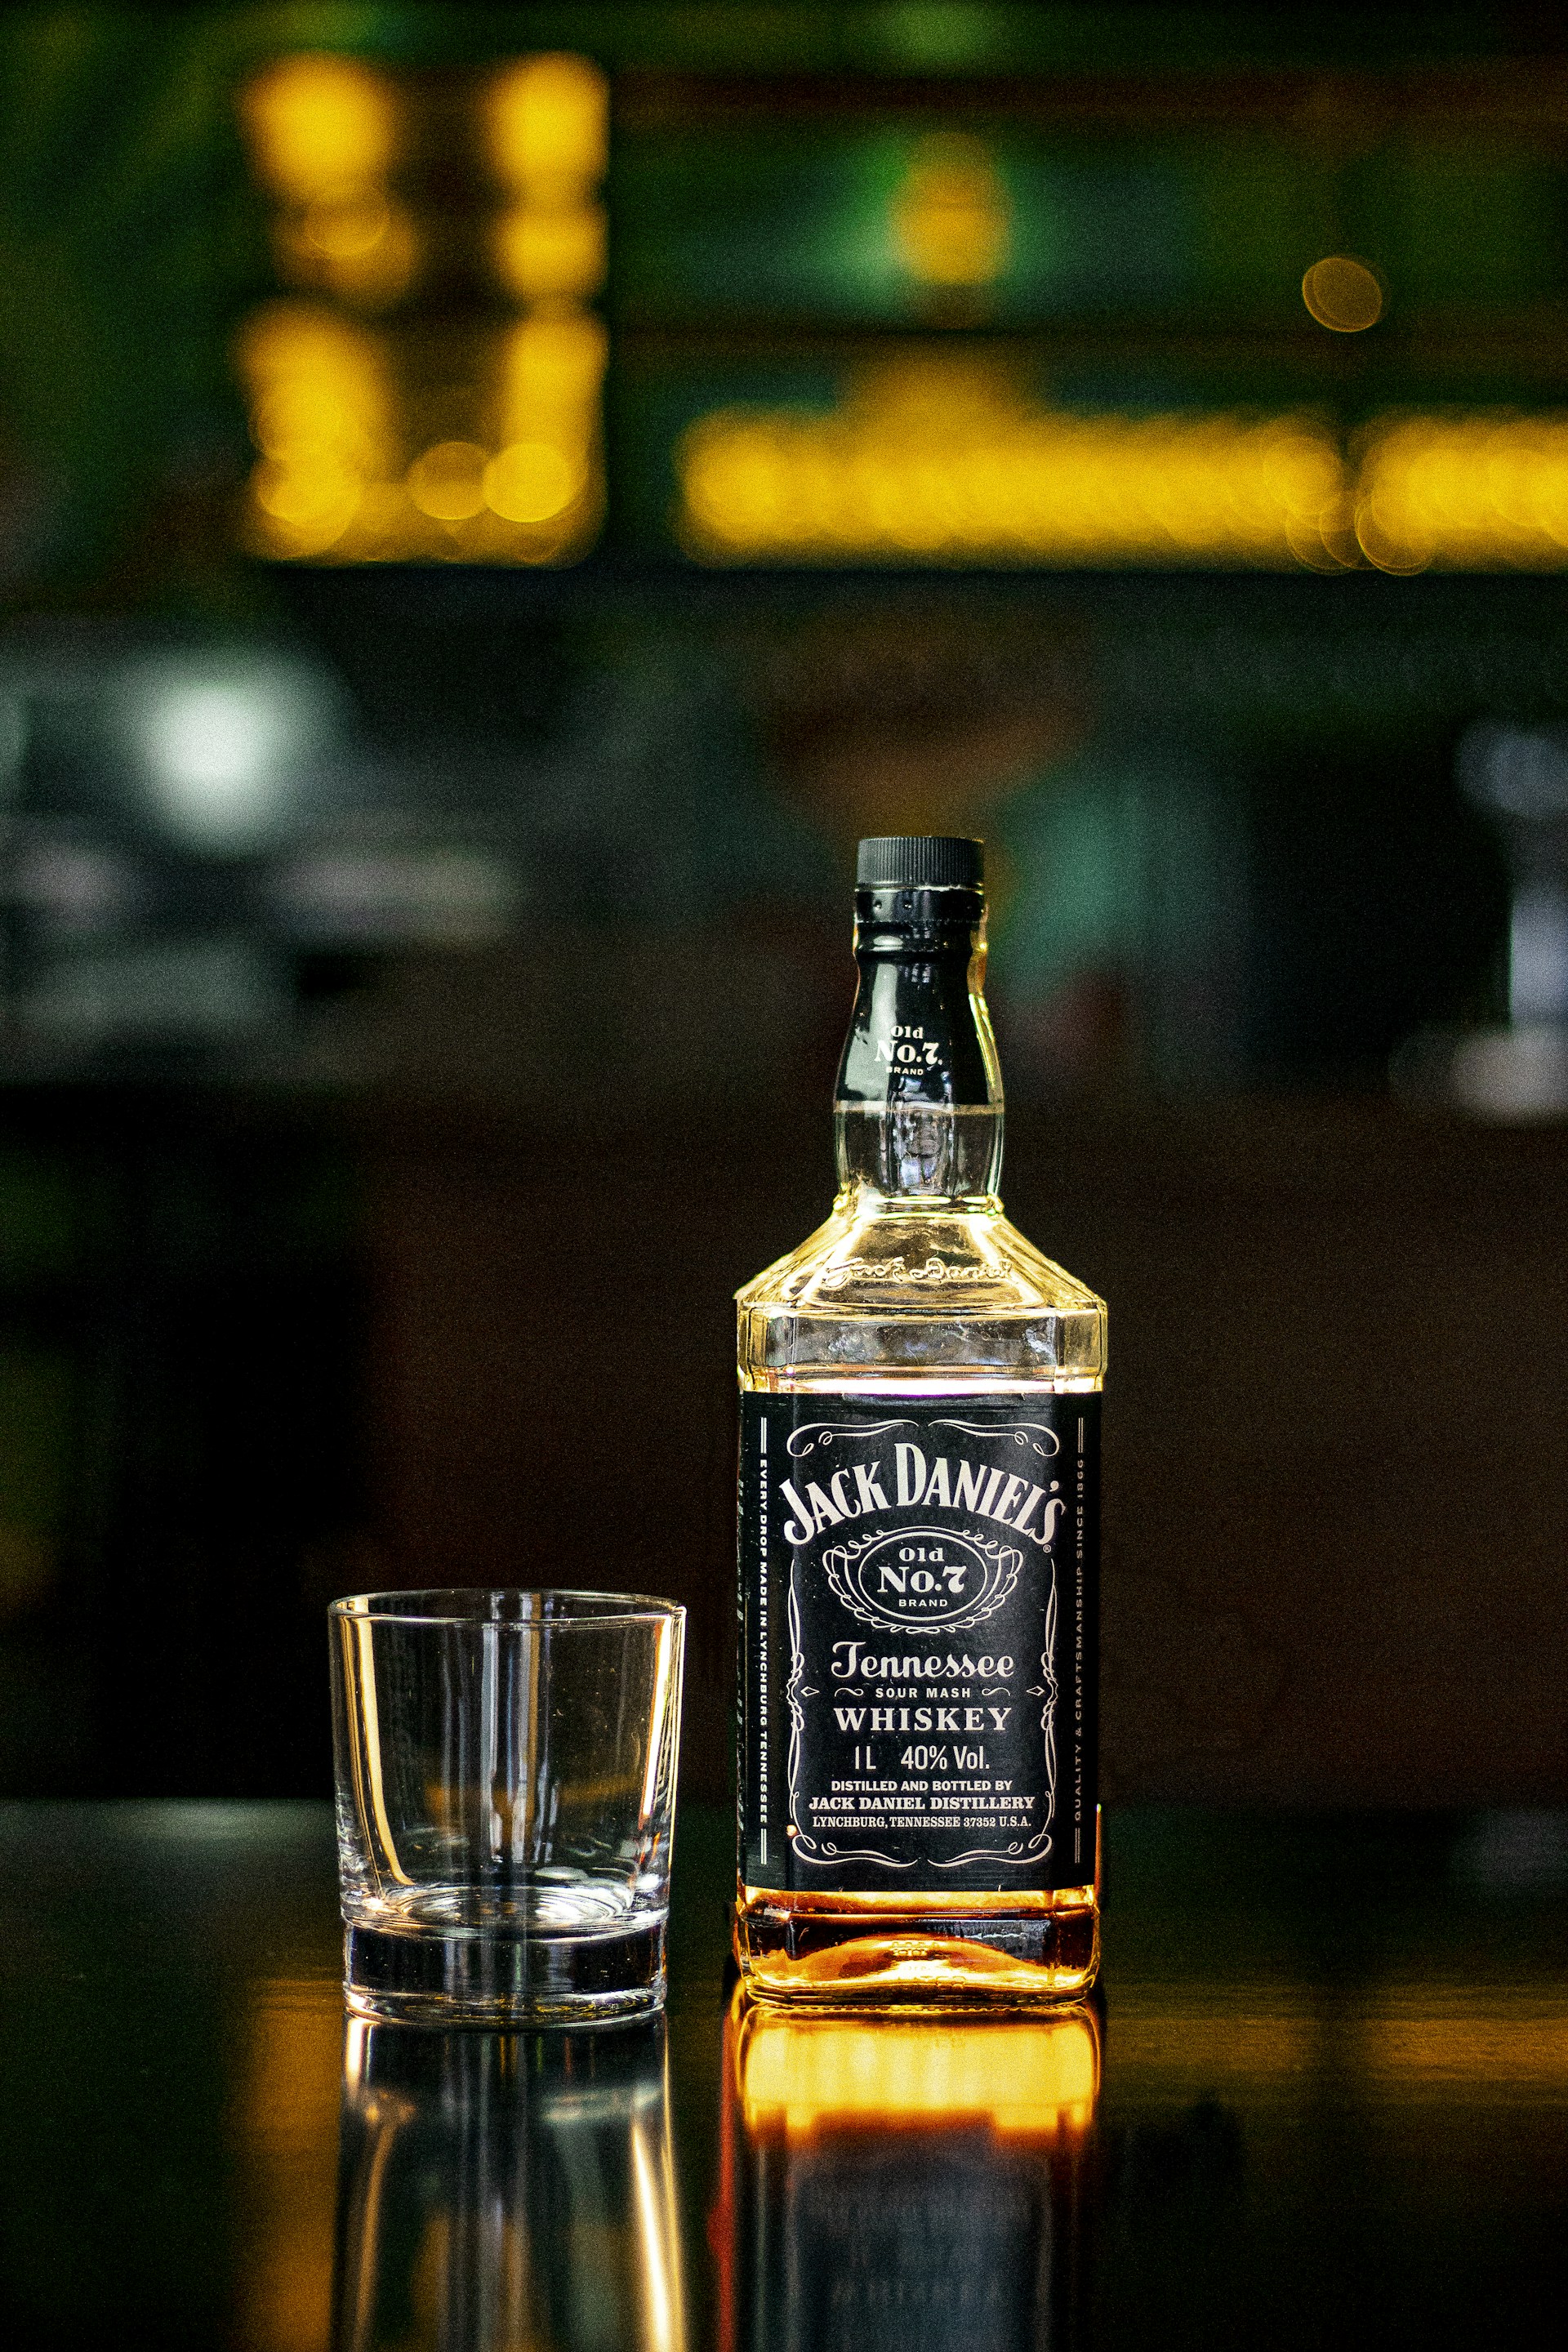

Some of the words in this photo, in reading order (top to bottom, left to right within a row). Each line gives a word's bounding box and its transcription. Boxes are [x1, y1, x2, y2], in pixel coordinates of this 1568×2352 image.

[890, 1026, 924, 1039] Old
[885, 1066, 924, 1076] BRAND
[760, 1459, 768, 1510] EVERY
[779, 1461, 893, 1545] JACK
[893, 1442, 1067, 1545] DANIEL'S
[760, 1514, 768, 1557] DROP
[899, 1548, 944, 1561] Old
[760, 1561, 768, 1606] MADE
[878, 1566, 966, 1593] No.7
[760, 1610, 768, 1627] IN
[1075, 1566, 1083, 1721] CRAFTSMANSHIP
[831, 1642, 1013, 1677] Tennessee
[760, 1632, 768, 1726] LYNCHBURG
[876, 1688, 917, 1698] SOUR
[927, 1688, 970, 1698] MASH
[834, 1708, 1011, 1731] WHISKEY
[1075, 1727, 1082, 1737] &
[854, 1746, 860, 1770] 1
[866, 1746, 875, 1769] L
[901, 1746, 947, 1770] 40%
[954, 1746, 989, 1769] Vol.
[760, 1731, 768, 1824] TENNESSEE
[832, 1781, 897, 1791] DISTILLED
[901, 1781, 928, 1791] AND
[933, 1780, 991, 1791] BOTTLED
[996, 1780, 1012, 1790] BY
[809, 1797, 854, 1810] JACK
[859, 1797, 924, 1809] DANIEL
[930, 1797, 1035, 1809] DISTILLERY
[813, 1816, 889, 1829] LYNCHBURG,
[889, 1816, 960, 1828] TENNESSEE
[963, 1816, 996, 1828] 37352
[999, 1815, 1032, 1828] U.S.A.
